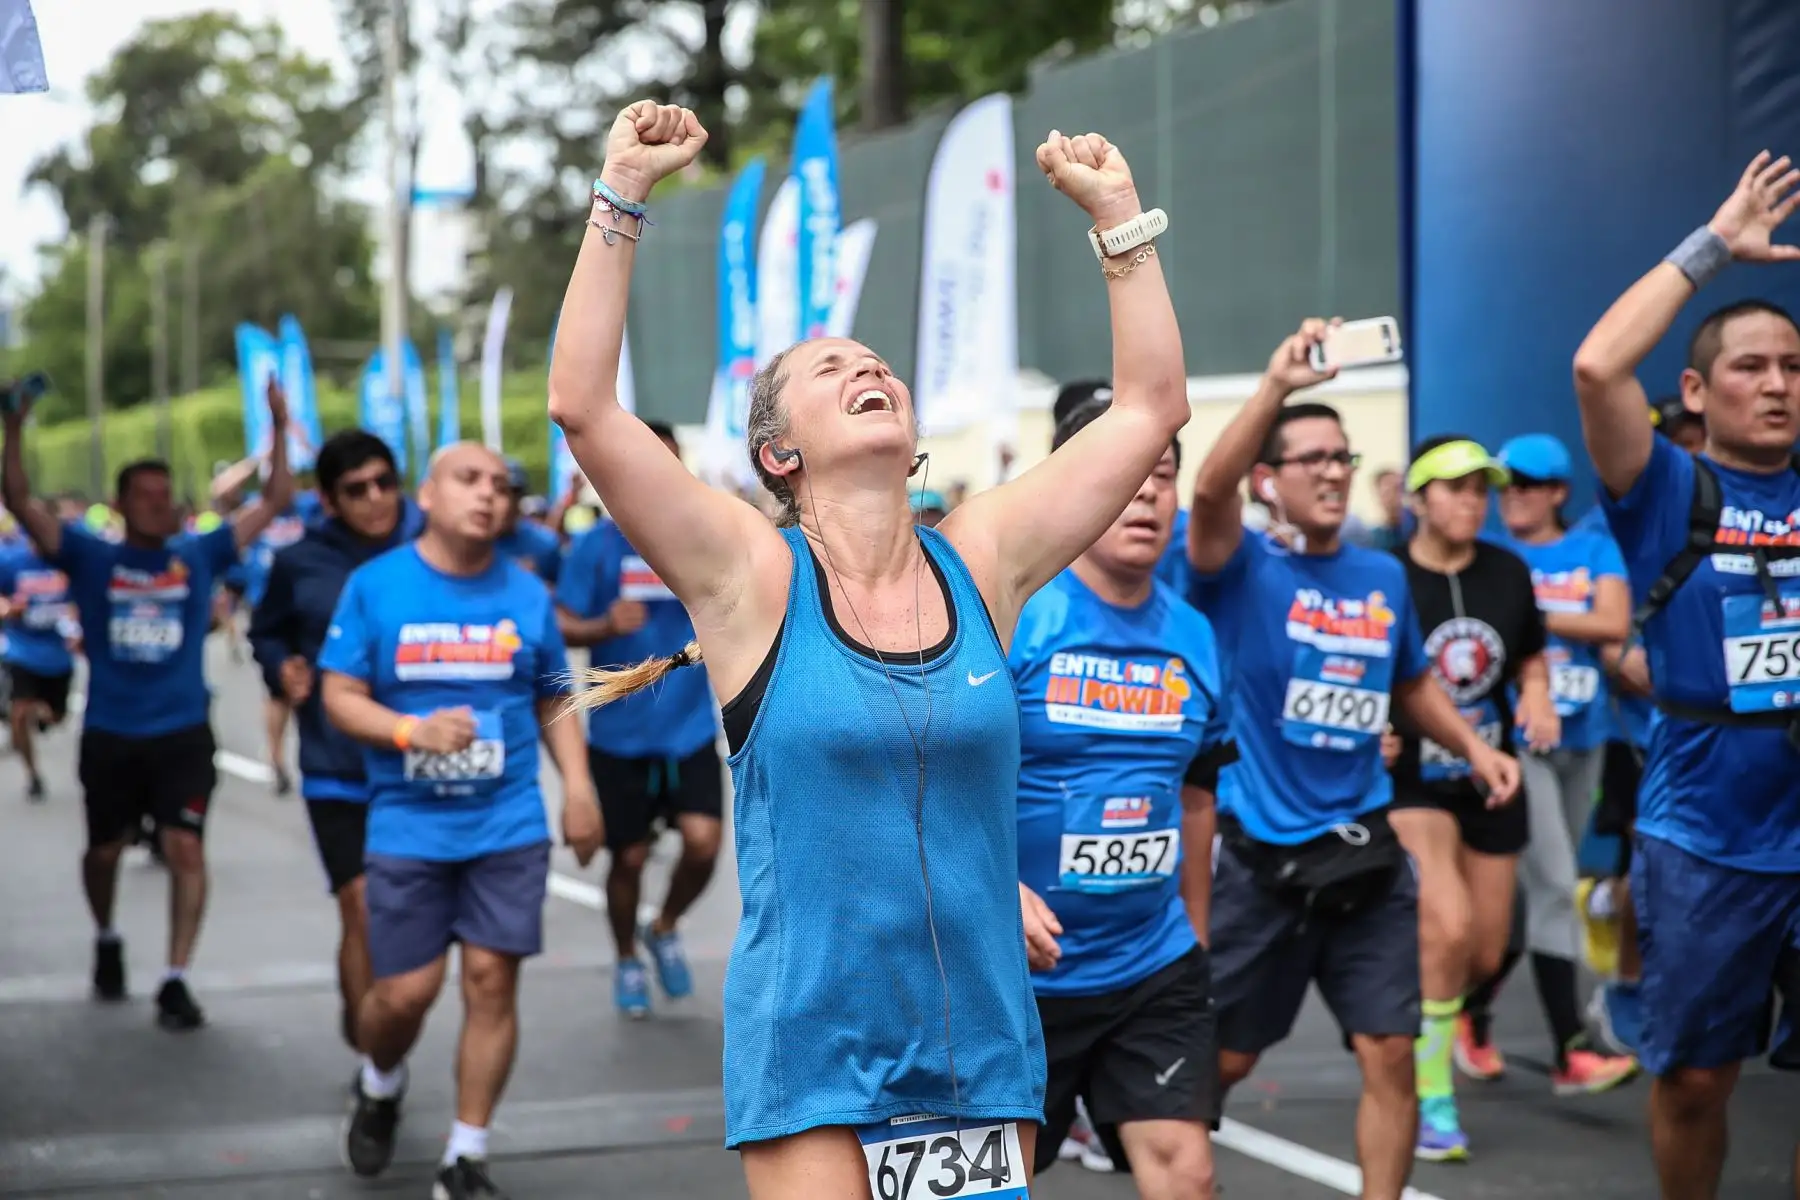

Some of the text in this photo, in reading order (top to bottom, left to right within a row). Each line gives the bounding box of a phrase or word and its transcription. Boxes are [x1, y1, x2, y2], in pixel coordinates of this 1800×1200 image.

[1049, 653, 1123, 682] ENTEL
[1082, 679, 1182, 715] POWER
[1292, 686, 1378, 729] 6190
[1069, 836, 1170, 877] 5857
[877, 1130, 1008, 1200] 6734
